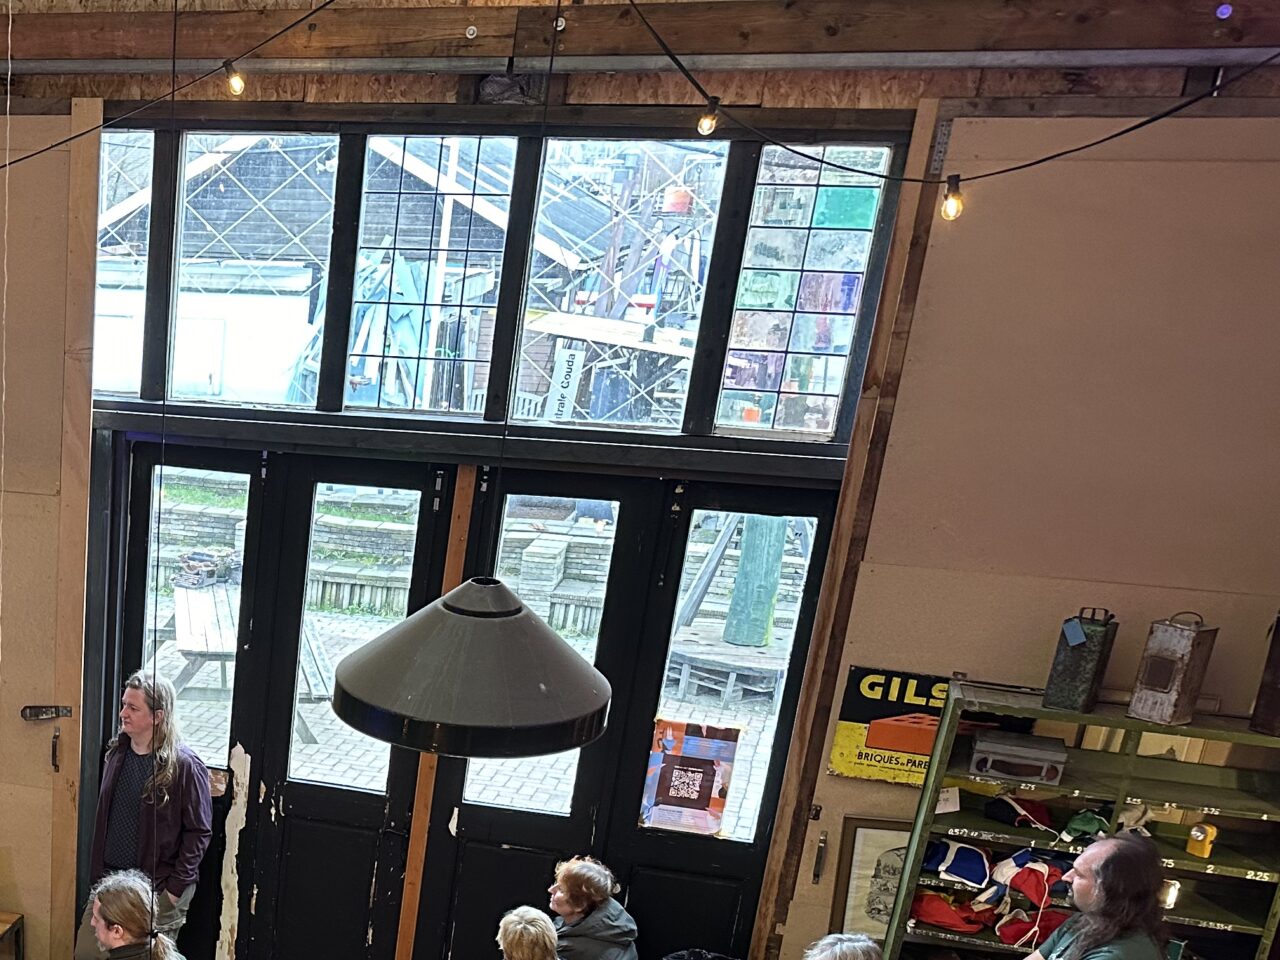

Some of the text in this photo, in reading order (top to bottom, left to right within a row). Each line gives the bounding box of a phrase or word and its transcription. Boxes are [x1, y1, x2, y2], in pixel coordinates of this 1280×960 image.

[561, 353, 576, 389] Gouda
[857, 752, 900, 765] BRIQUES
[1245, 871, 1270, 881] 2.25
